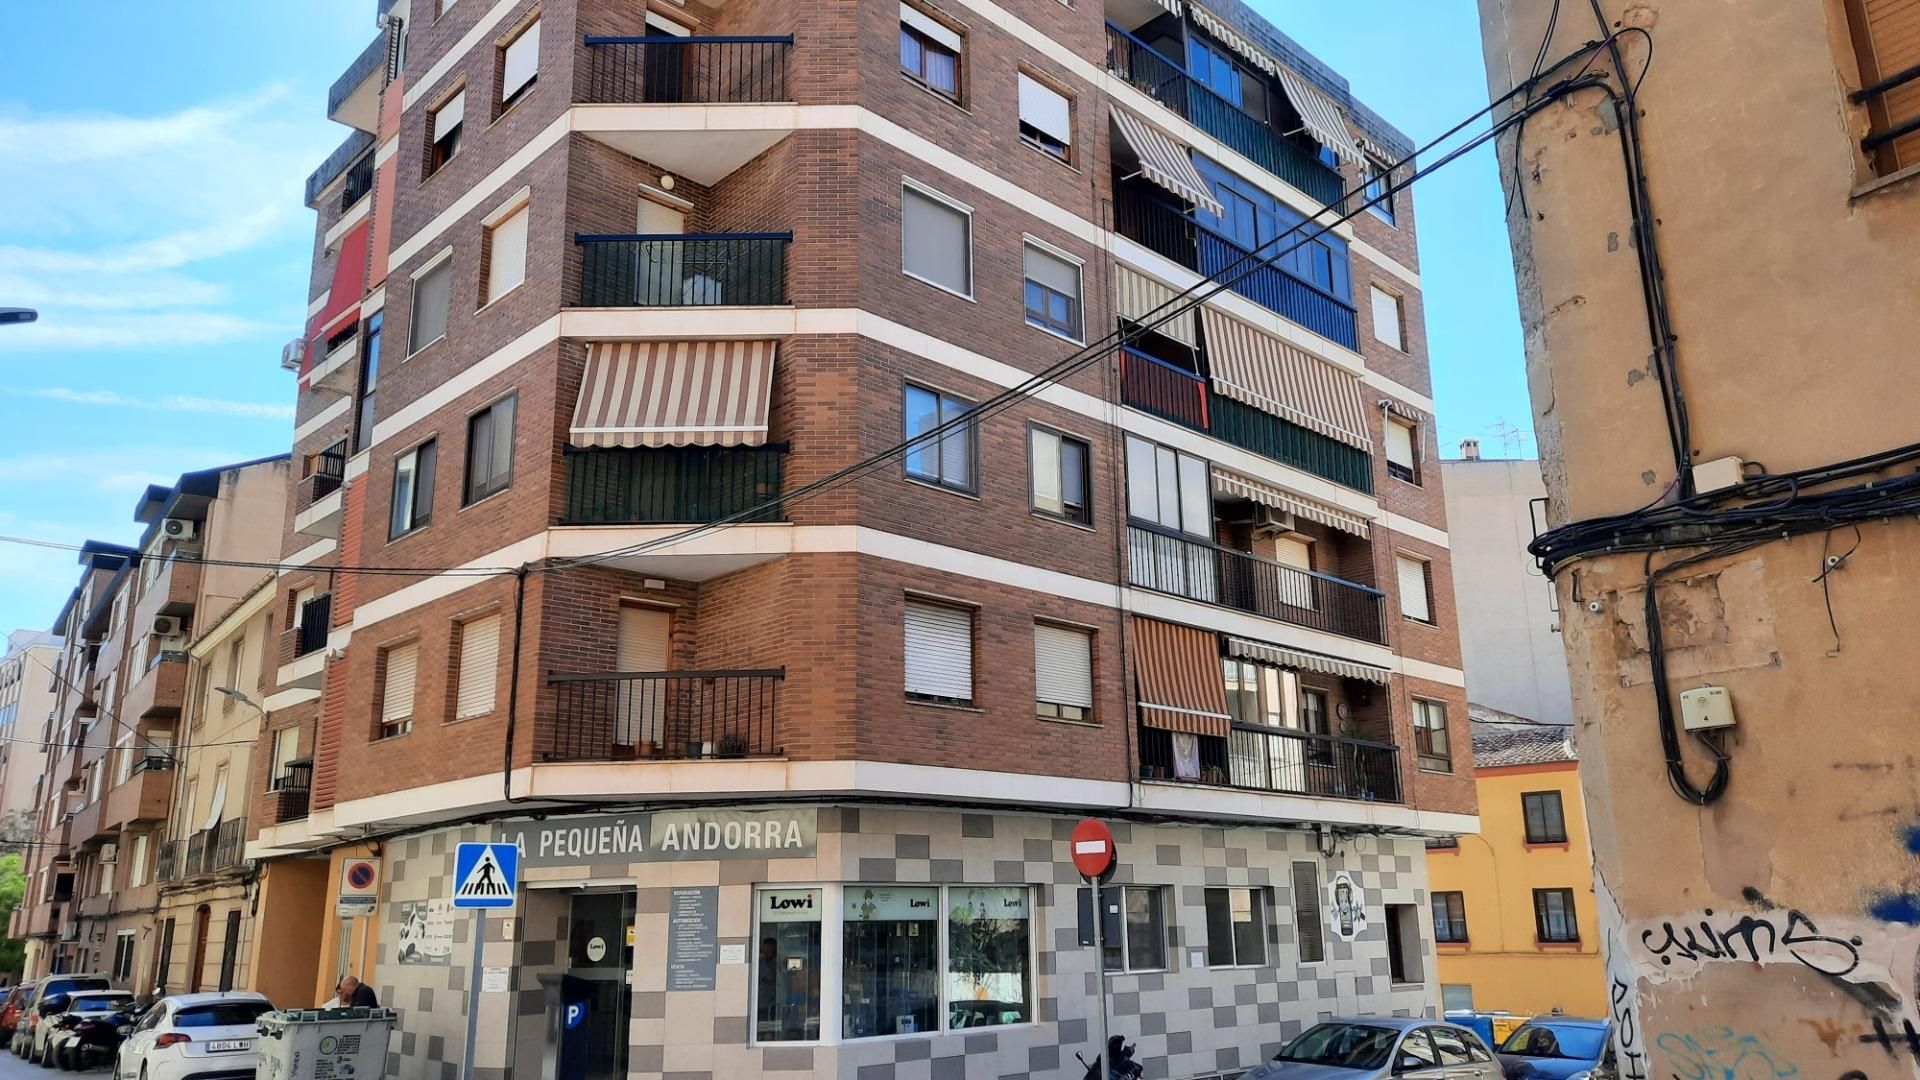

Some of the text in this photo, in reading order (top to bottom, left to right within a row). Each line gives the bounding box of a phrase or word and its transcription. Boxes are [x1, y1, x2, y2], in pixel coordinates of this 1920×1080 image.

[539, 819, 644, 858] PEQUEÑA
[661, 820, 803, 852] ANDORRA
[770, 894, 813, 909] Lowi
[910, 898, 930, 908] Lowi
[1003, 898, 1022, 907] Lowi
[567, 1005, 580, 1025] P
